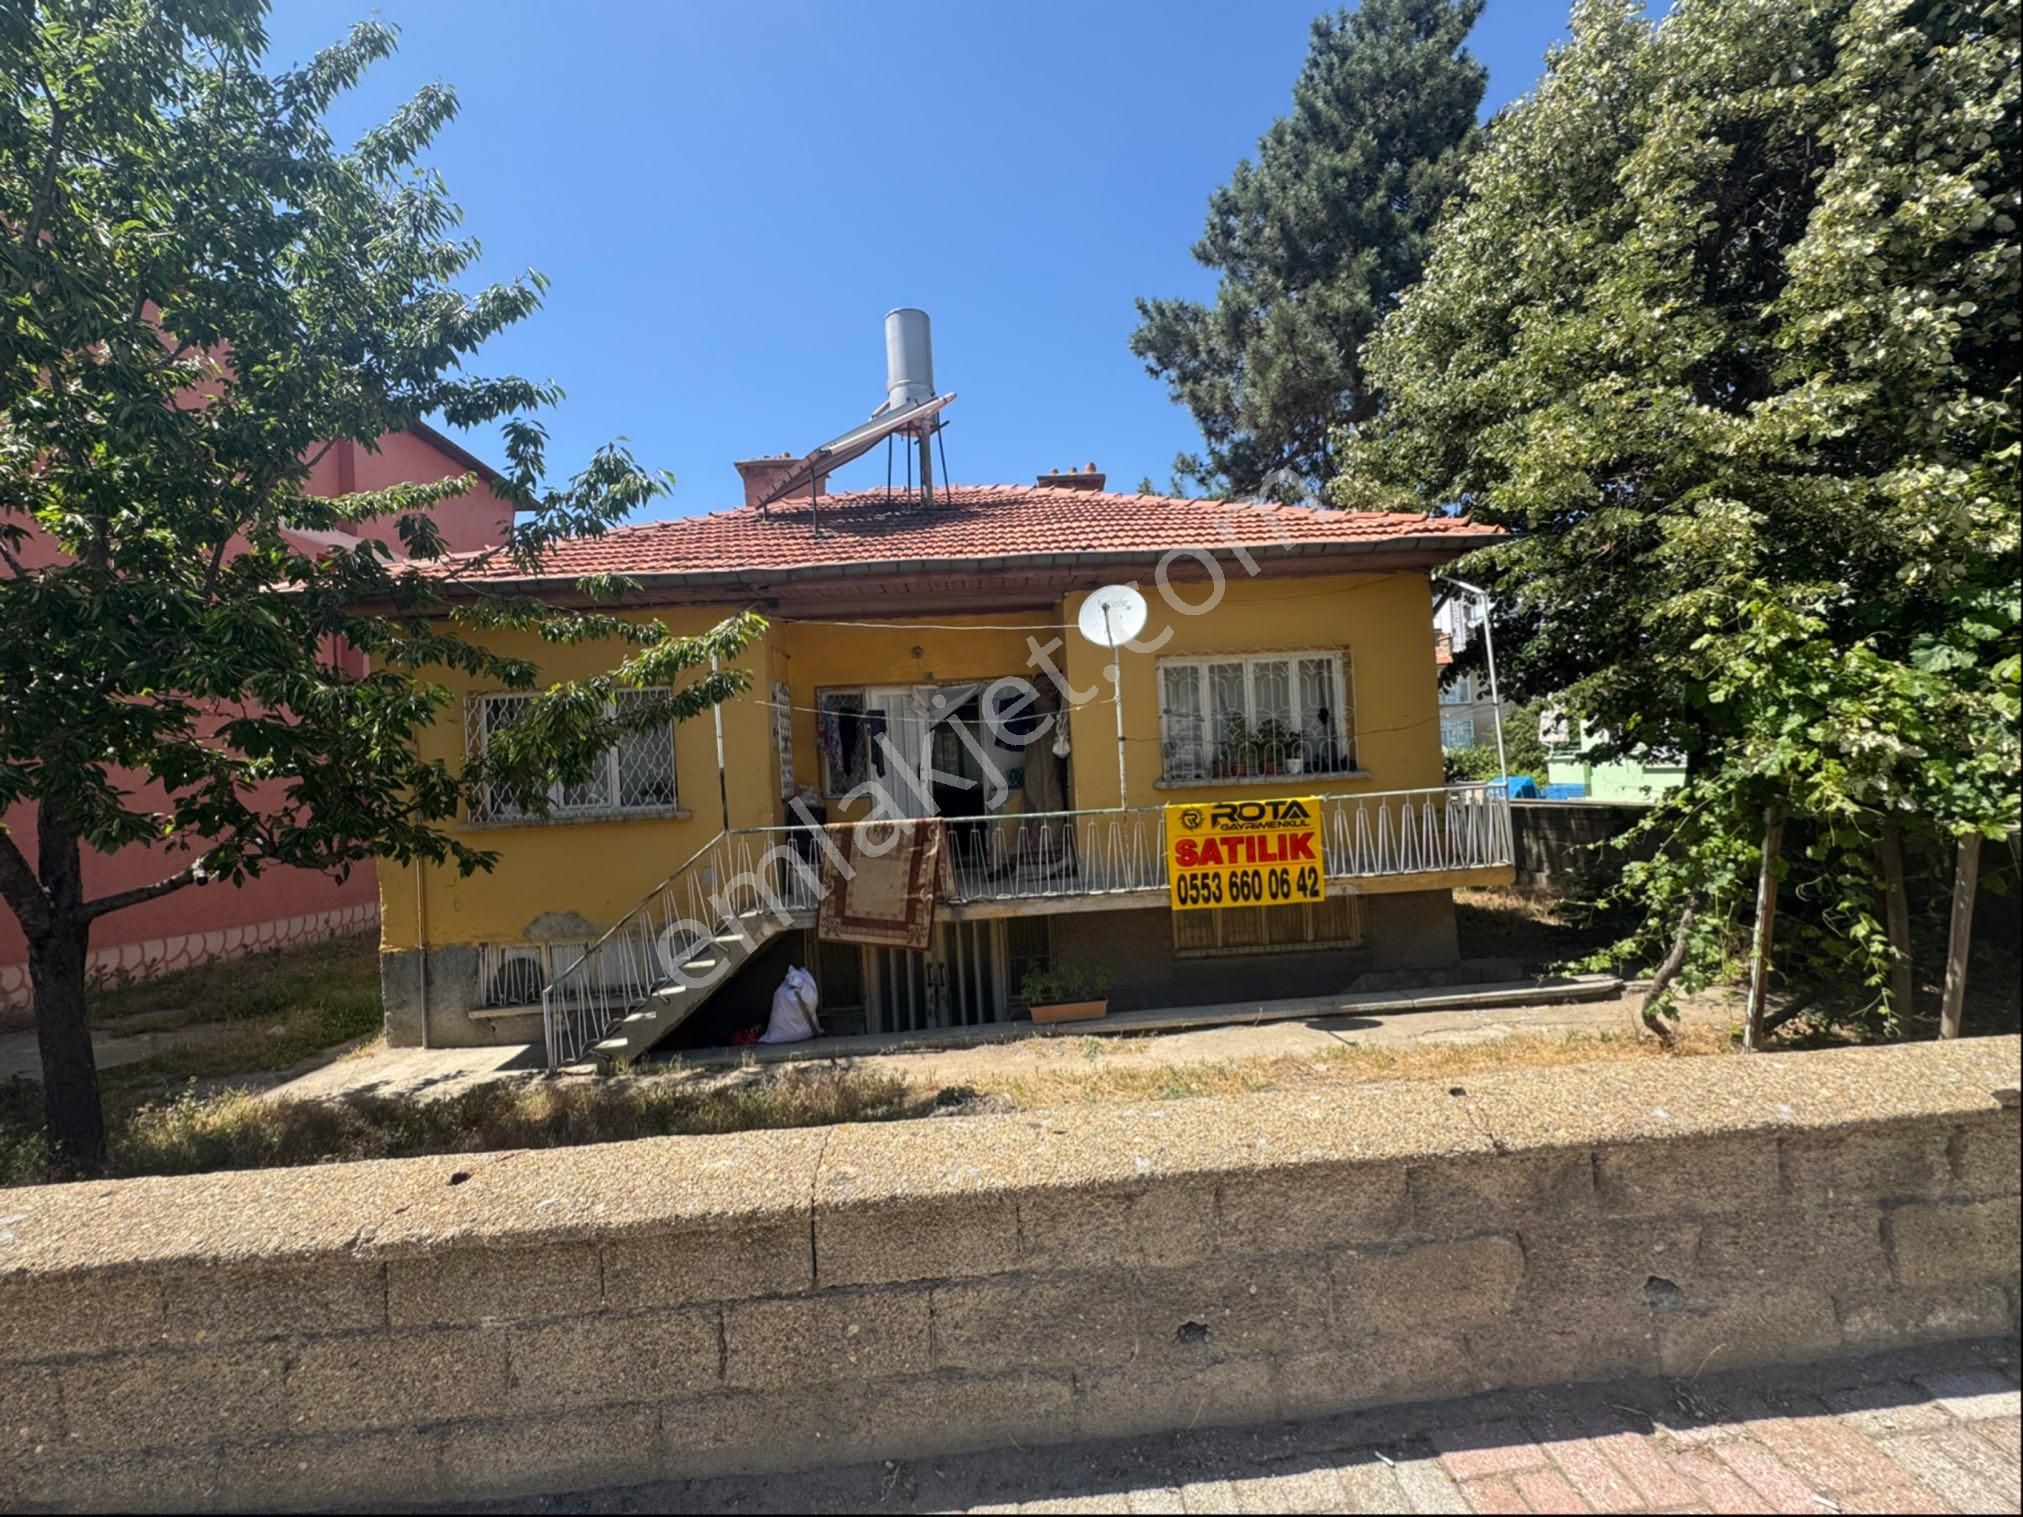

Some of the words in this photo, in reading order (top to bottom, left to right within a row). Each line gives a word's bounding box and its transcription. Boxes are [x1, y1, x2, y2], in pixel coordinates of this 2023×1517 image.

[1211, 800, 1310, 829] ROTA
[1175, 832, 1316, 867] SATILIK
[1177, 871, 1223, 905] 0553
[1229, 869, 1263, 902] 660
[1268, 868, 1291, 899] 06
[1297, 866, 1320, 898] 42
